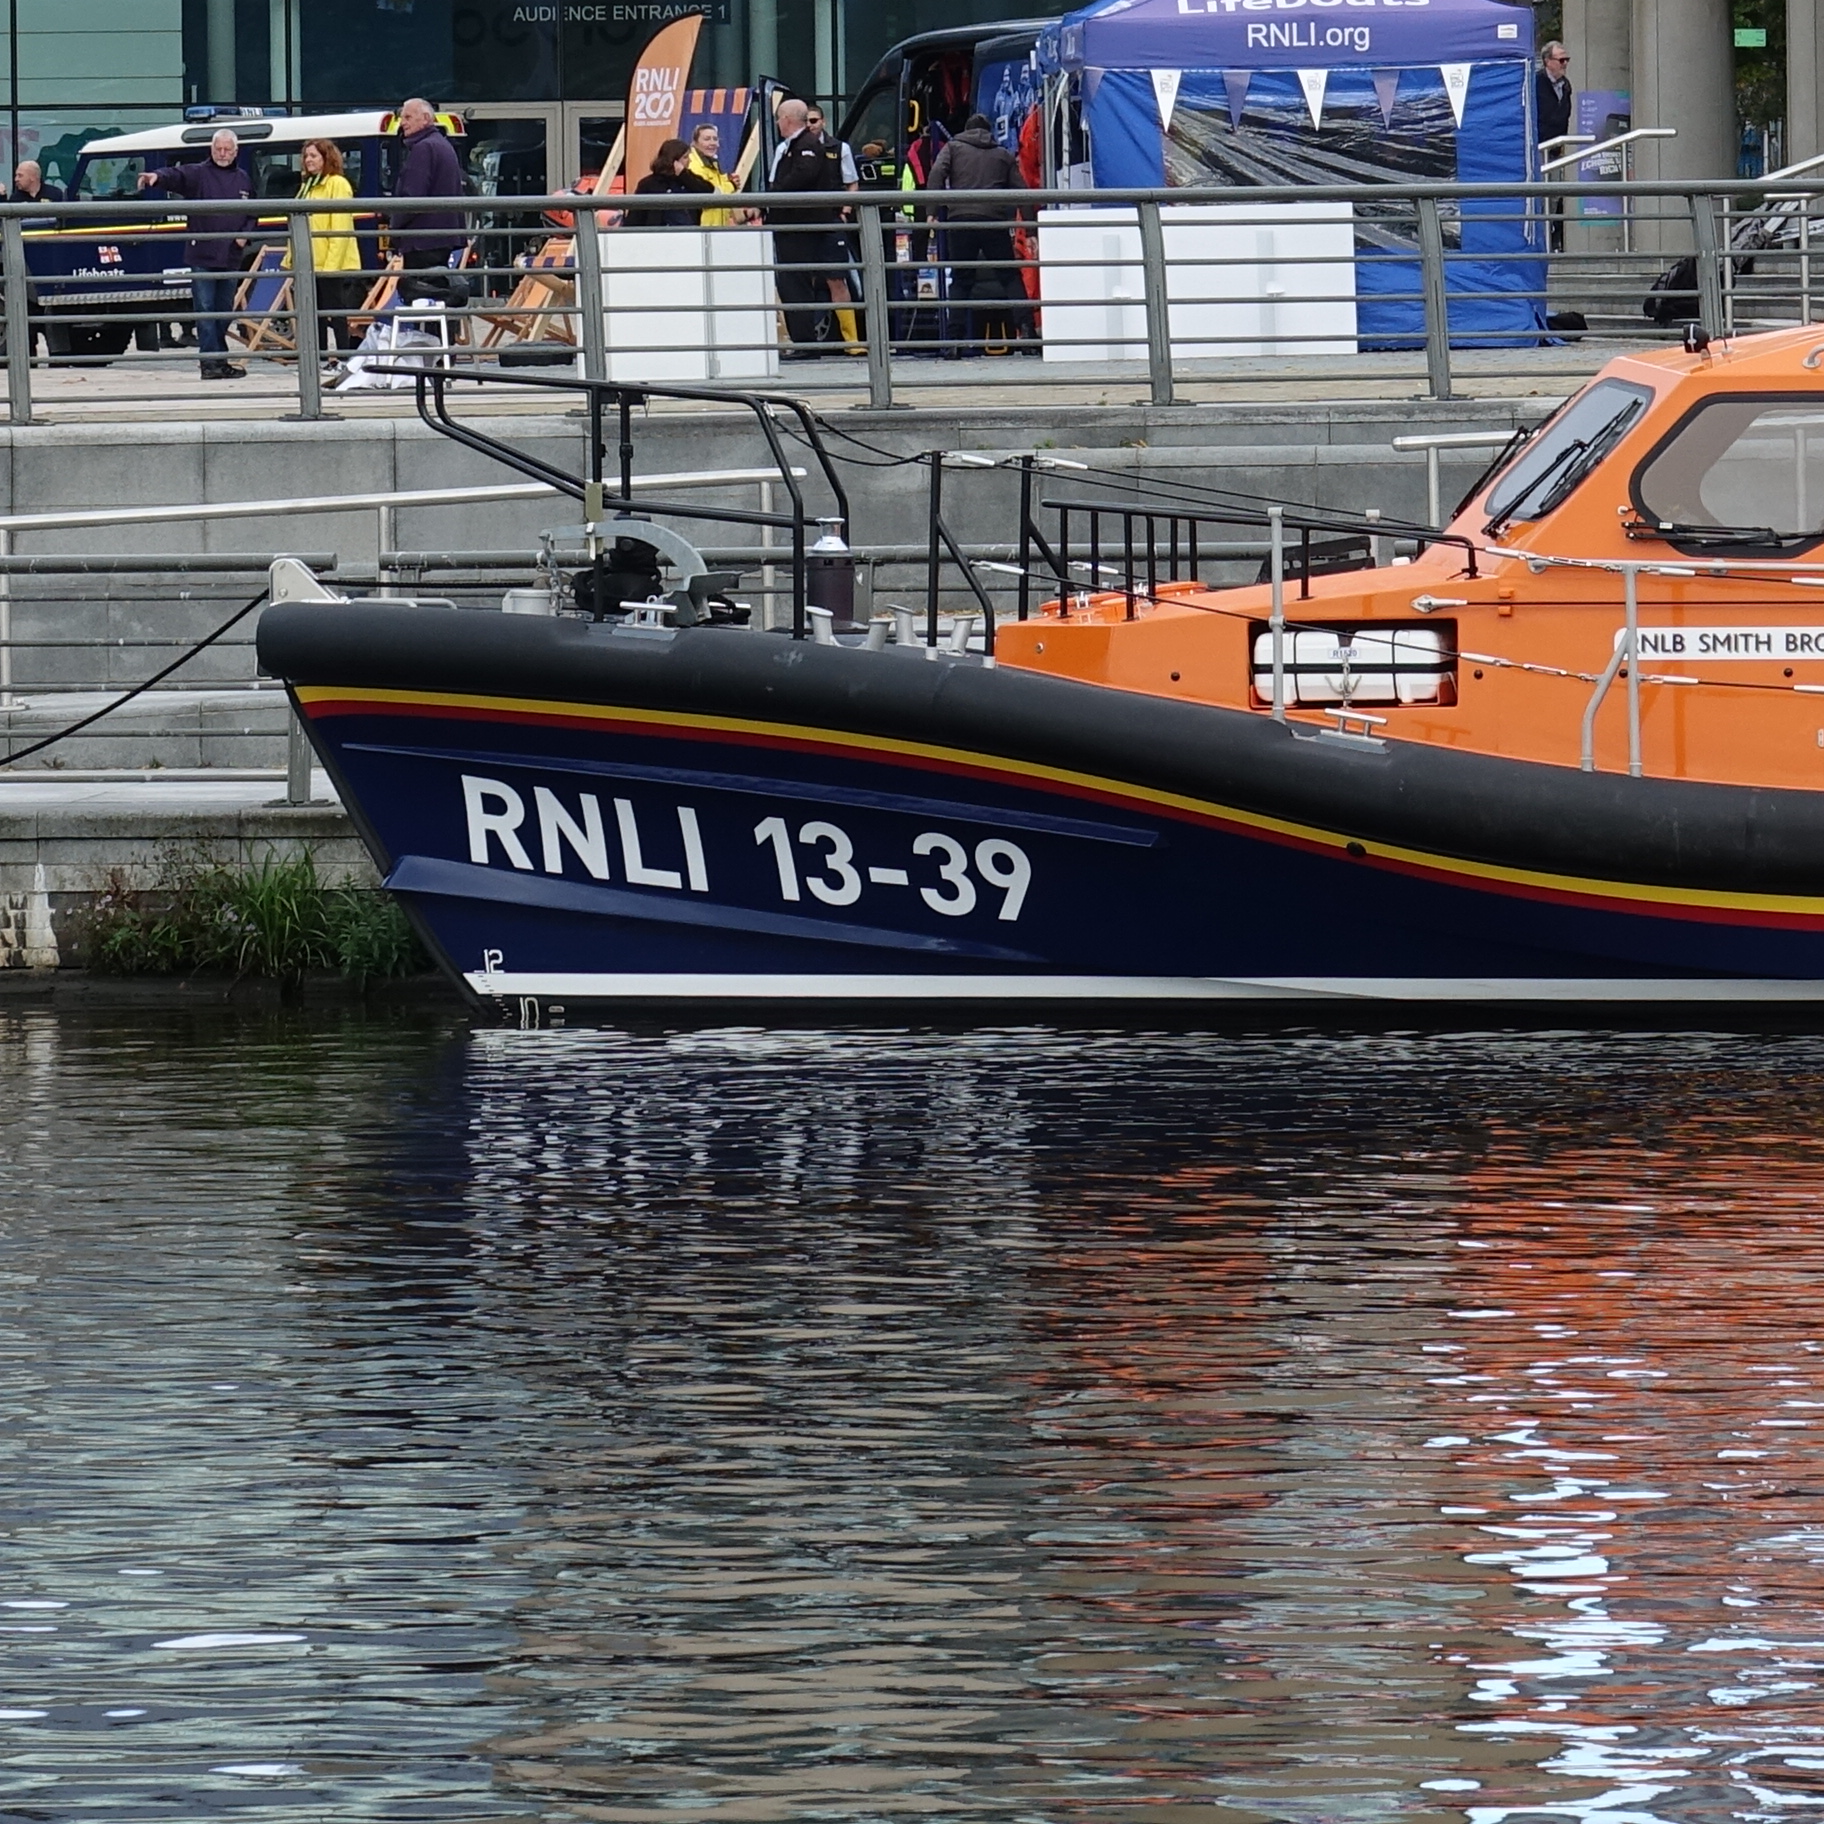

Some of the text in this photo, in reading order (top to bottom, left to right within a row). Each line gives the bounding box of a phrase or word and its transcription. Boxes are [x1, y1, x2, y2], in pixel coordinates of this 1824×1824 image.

[718, 4, 725, 19] 1
[1247, 22, 1370, 52] RNLI.org
[636, 67, 680, 92] RNLI
[634, 92, 675, 119] 200
[1636, 633, 1686, 653] NLB
[1699, 632, 1772, 653] SMITH
[461, 774, 1033, 922] RNLI 13-39
[484, 949, 505, 973] 12
